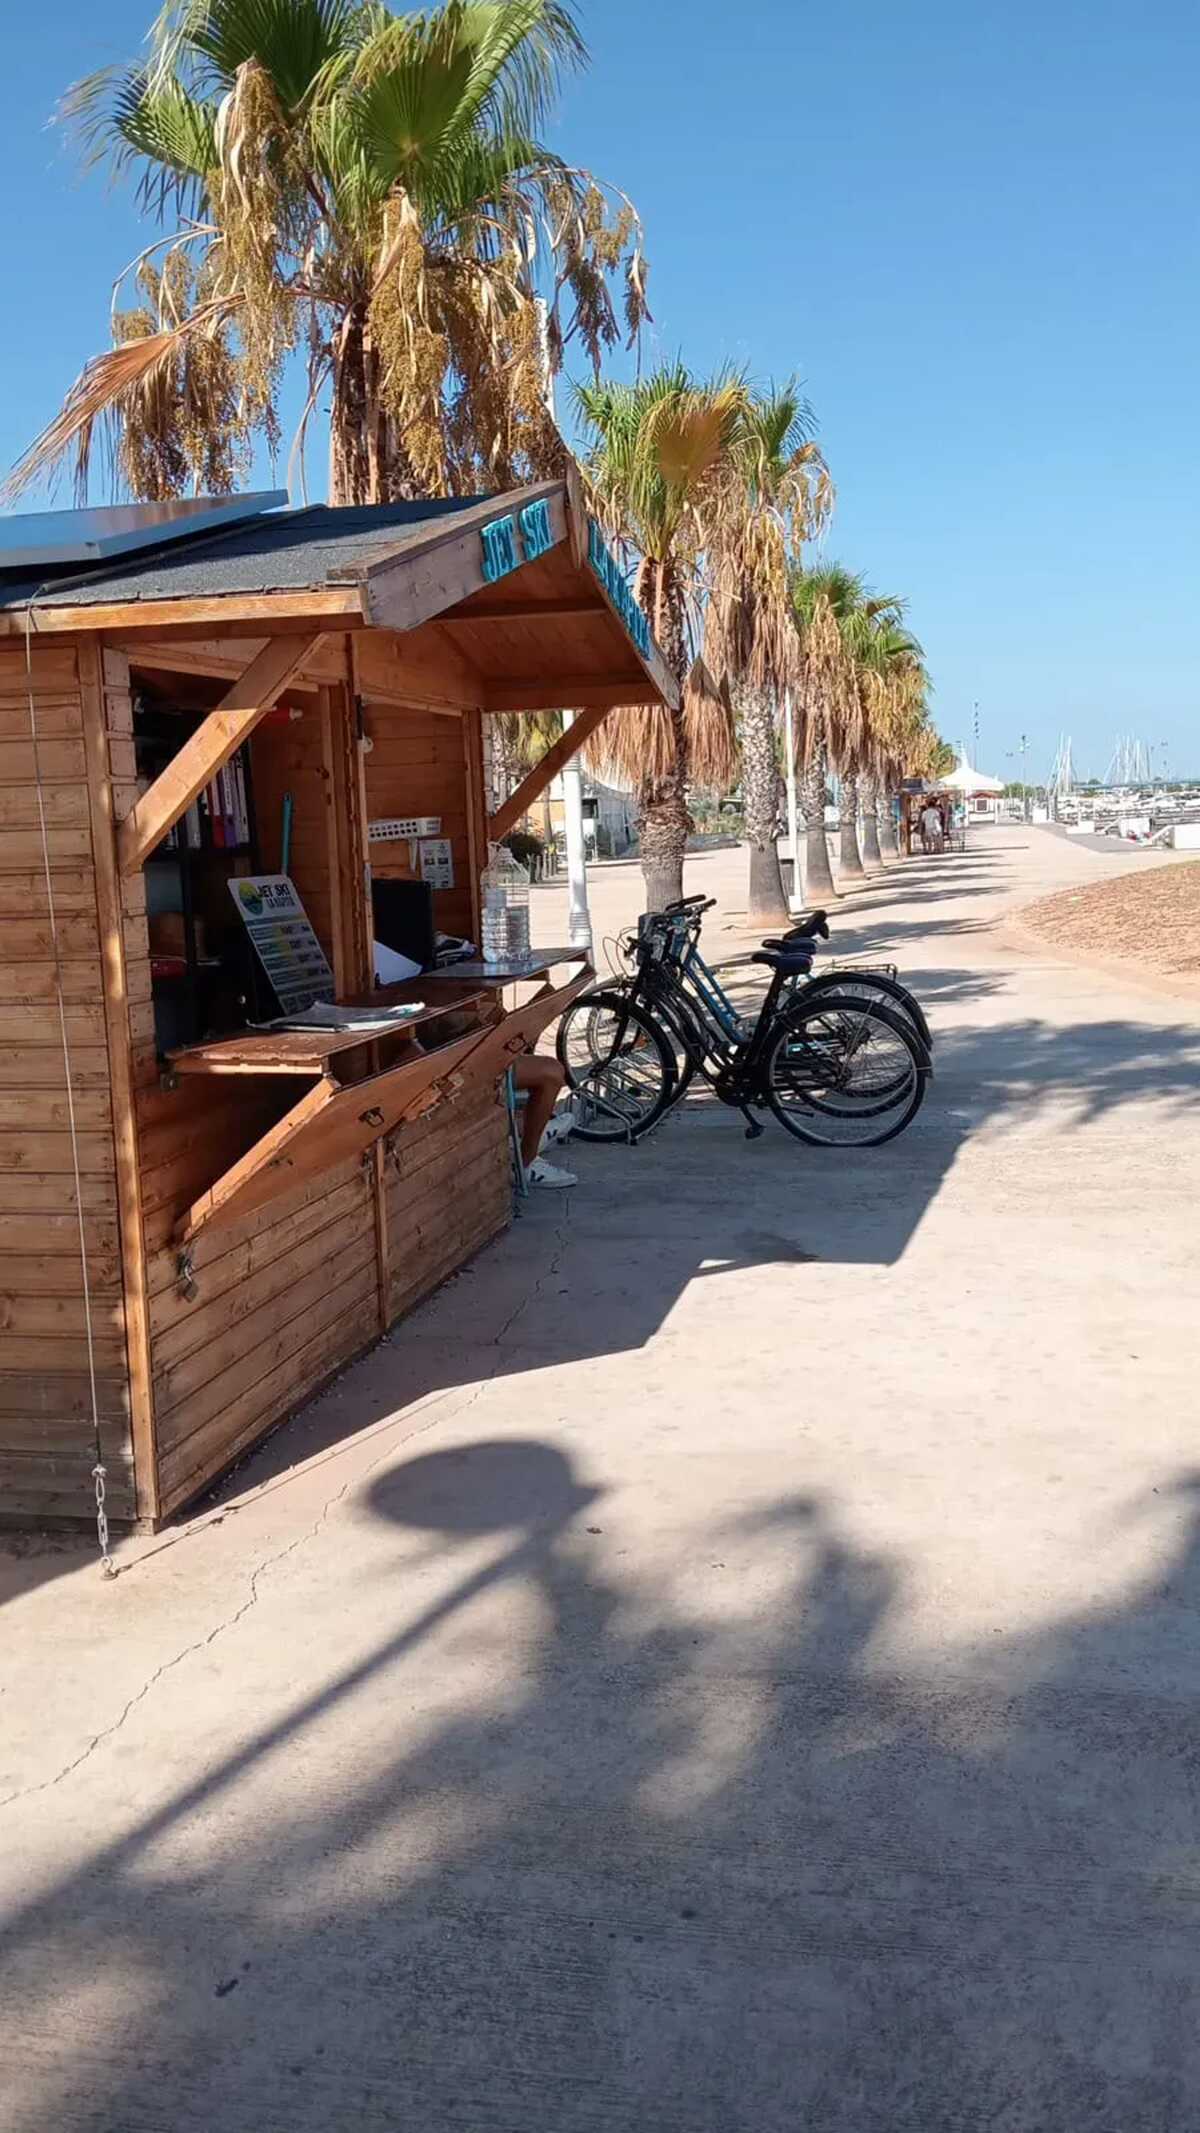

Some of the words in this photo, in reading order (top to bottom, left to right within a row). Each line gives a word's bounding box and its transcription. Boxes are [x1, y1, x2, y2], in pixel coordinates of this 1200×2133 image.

[481, 514, 519, 582] JET
[520, 498, 554, 561] SKI
[256, 885, 273, 897] JET
[274, 884, 291, 897] SKI
